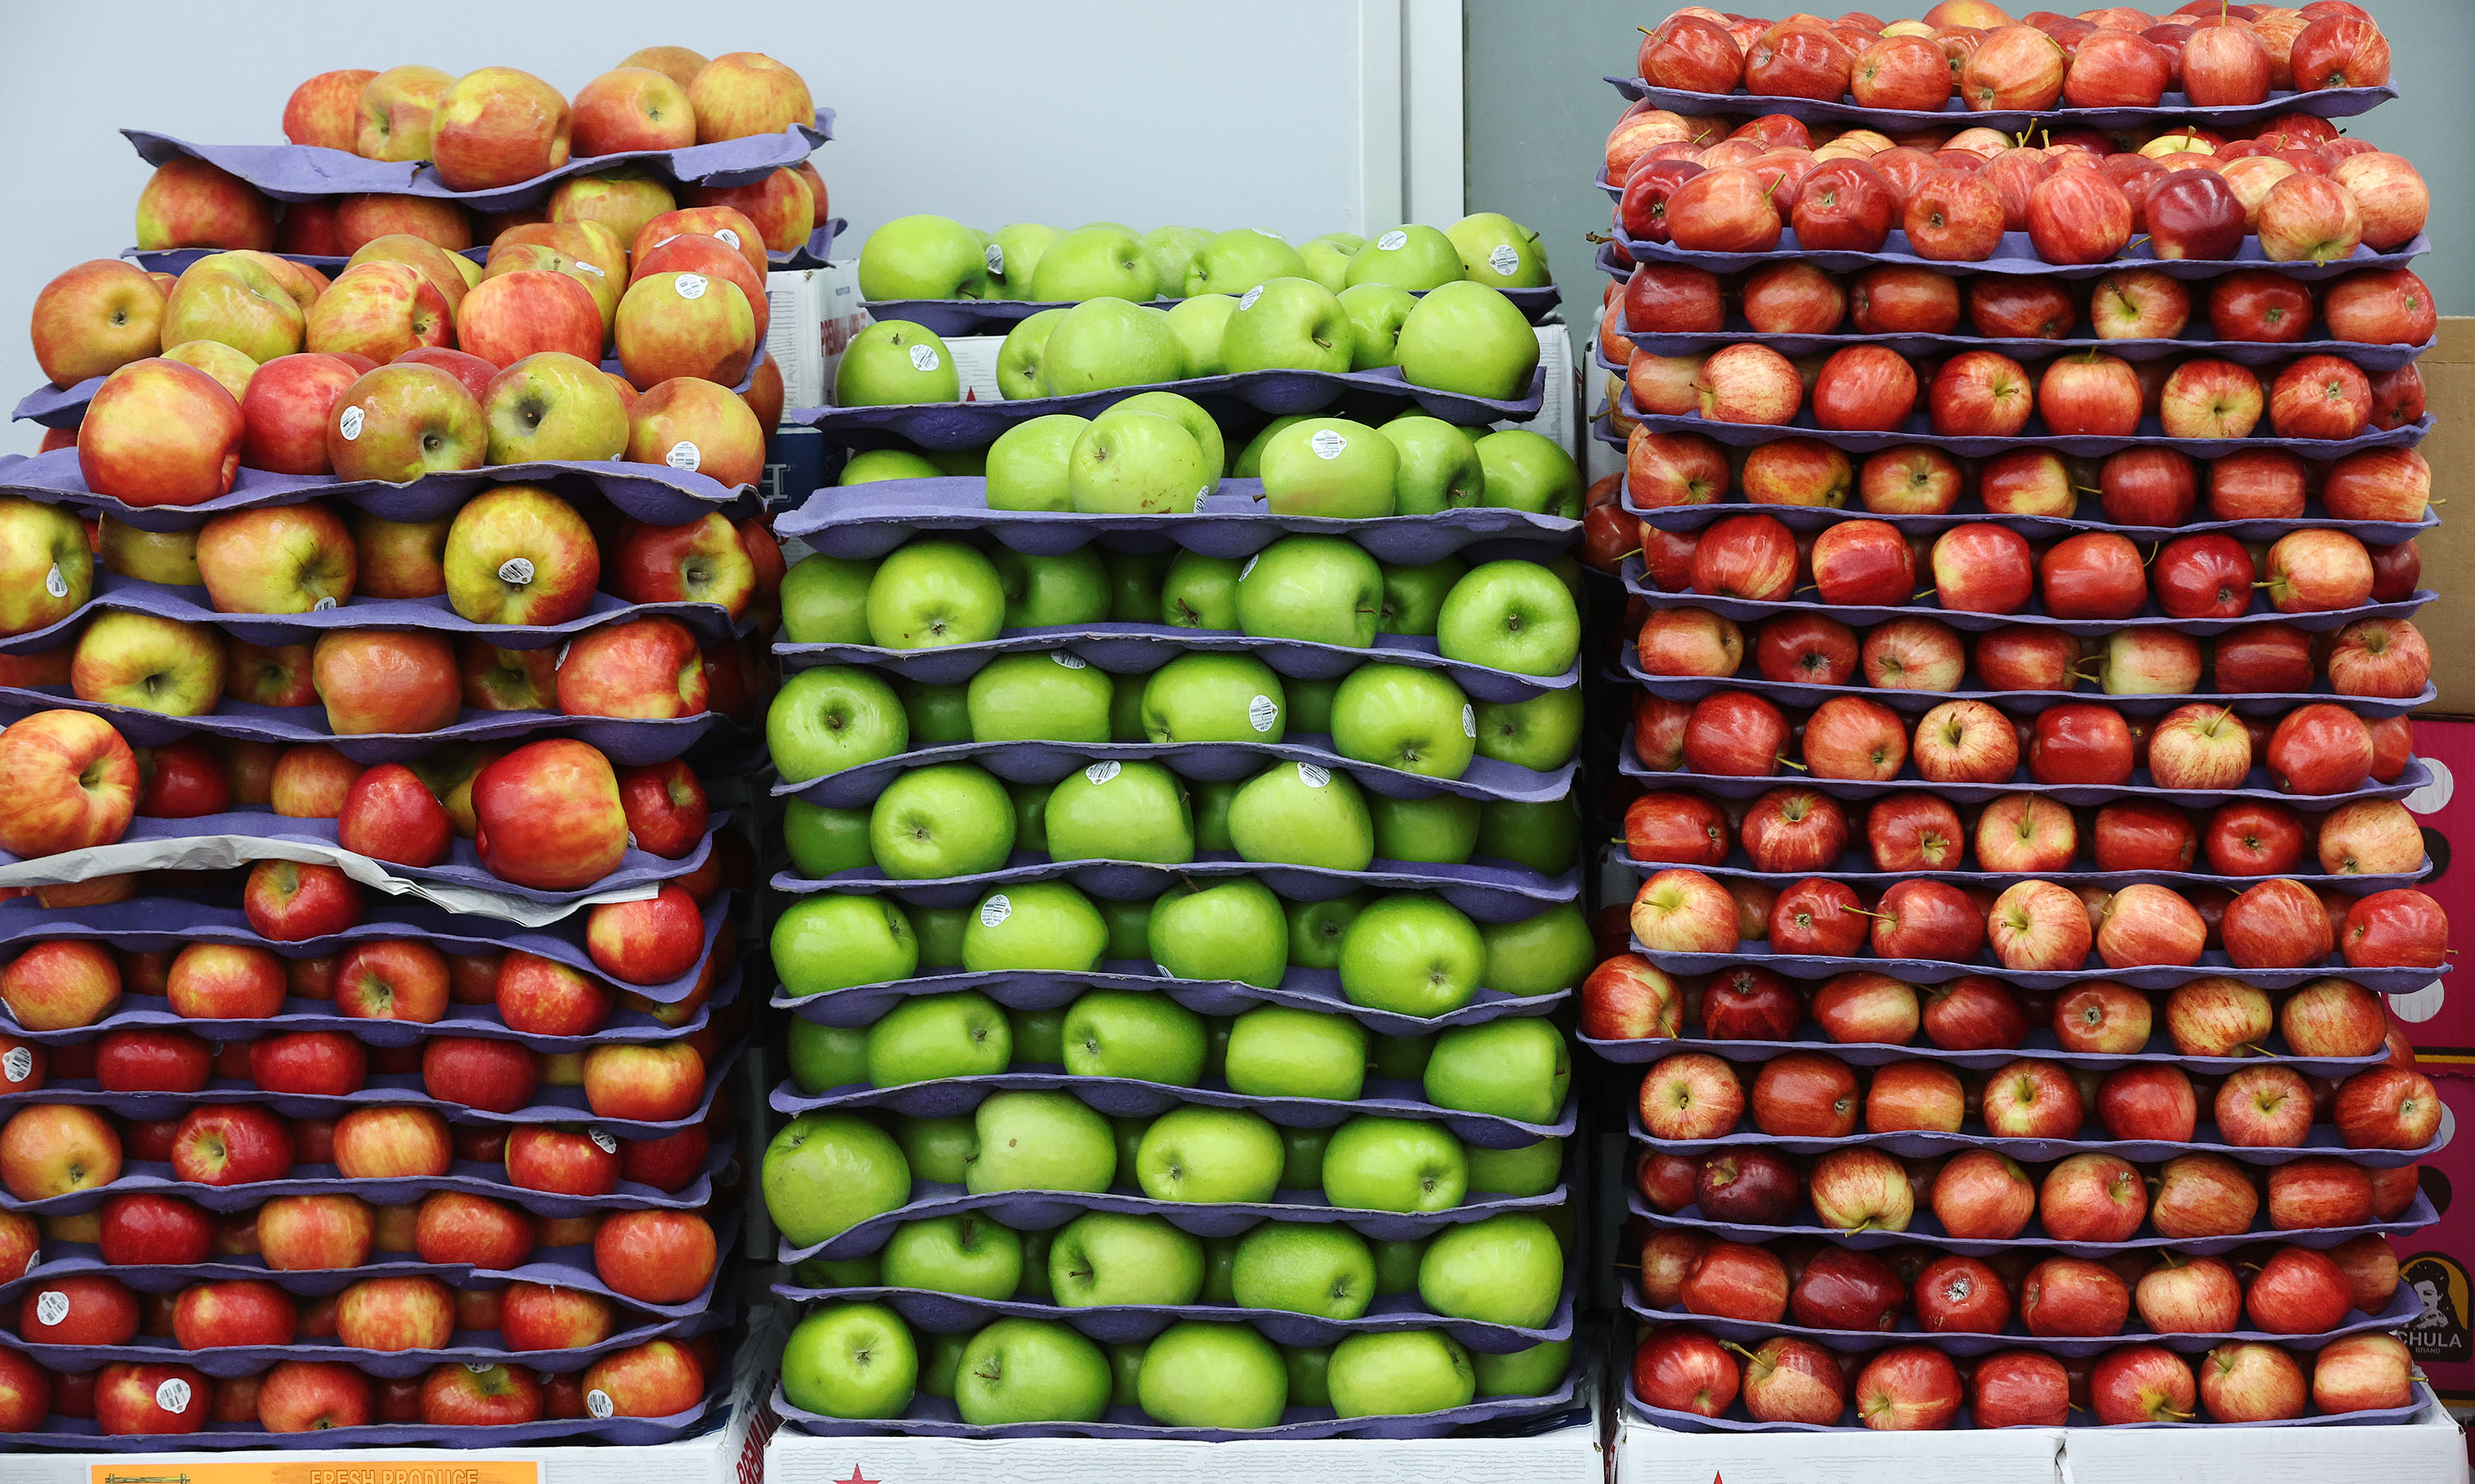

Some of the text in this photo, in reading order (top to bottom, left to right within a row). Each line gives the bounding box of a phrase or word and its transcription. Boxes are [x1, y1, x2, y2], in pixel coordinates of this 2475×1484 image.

[2397, 1331, 2462, 1348] CHULA
[310, 1469, 478, 1484] FRESH PRODUCE
